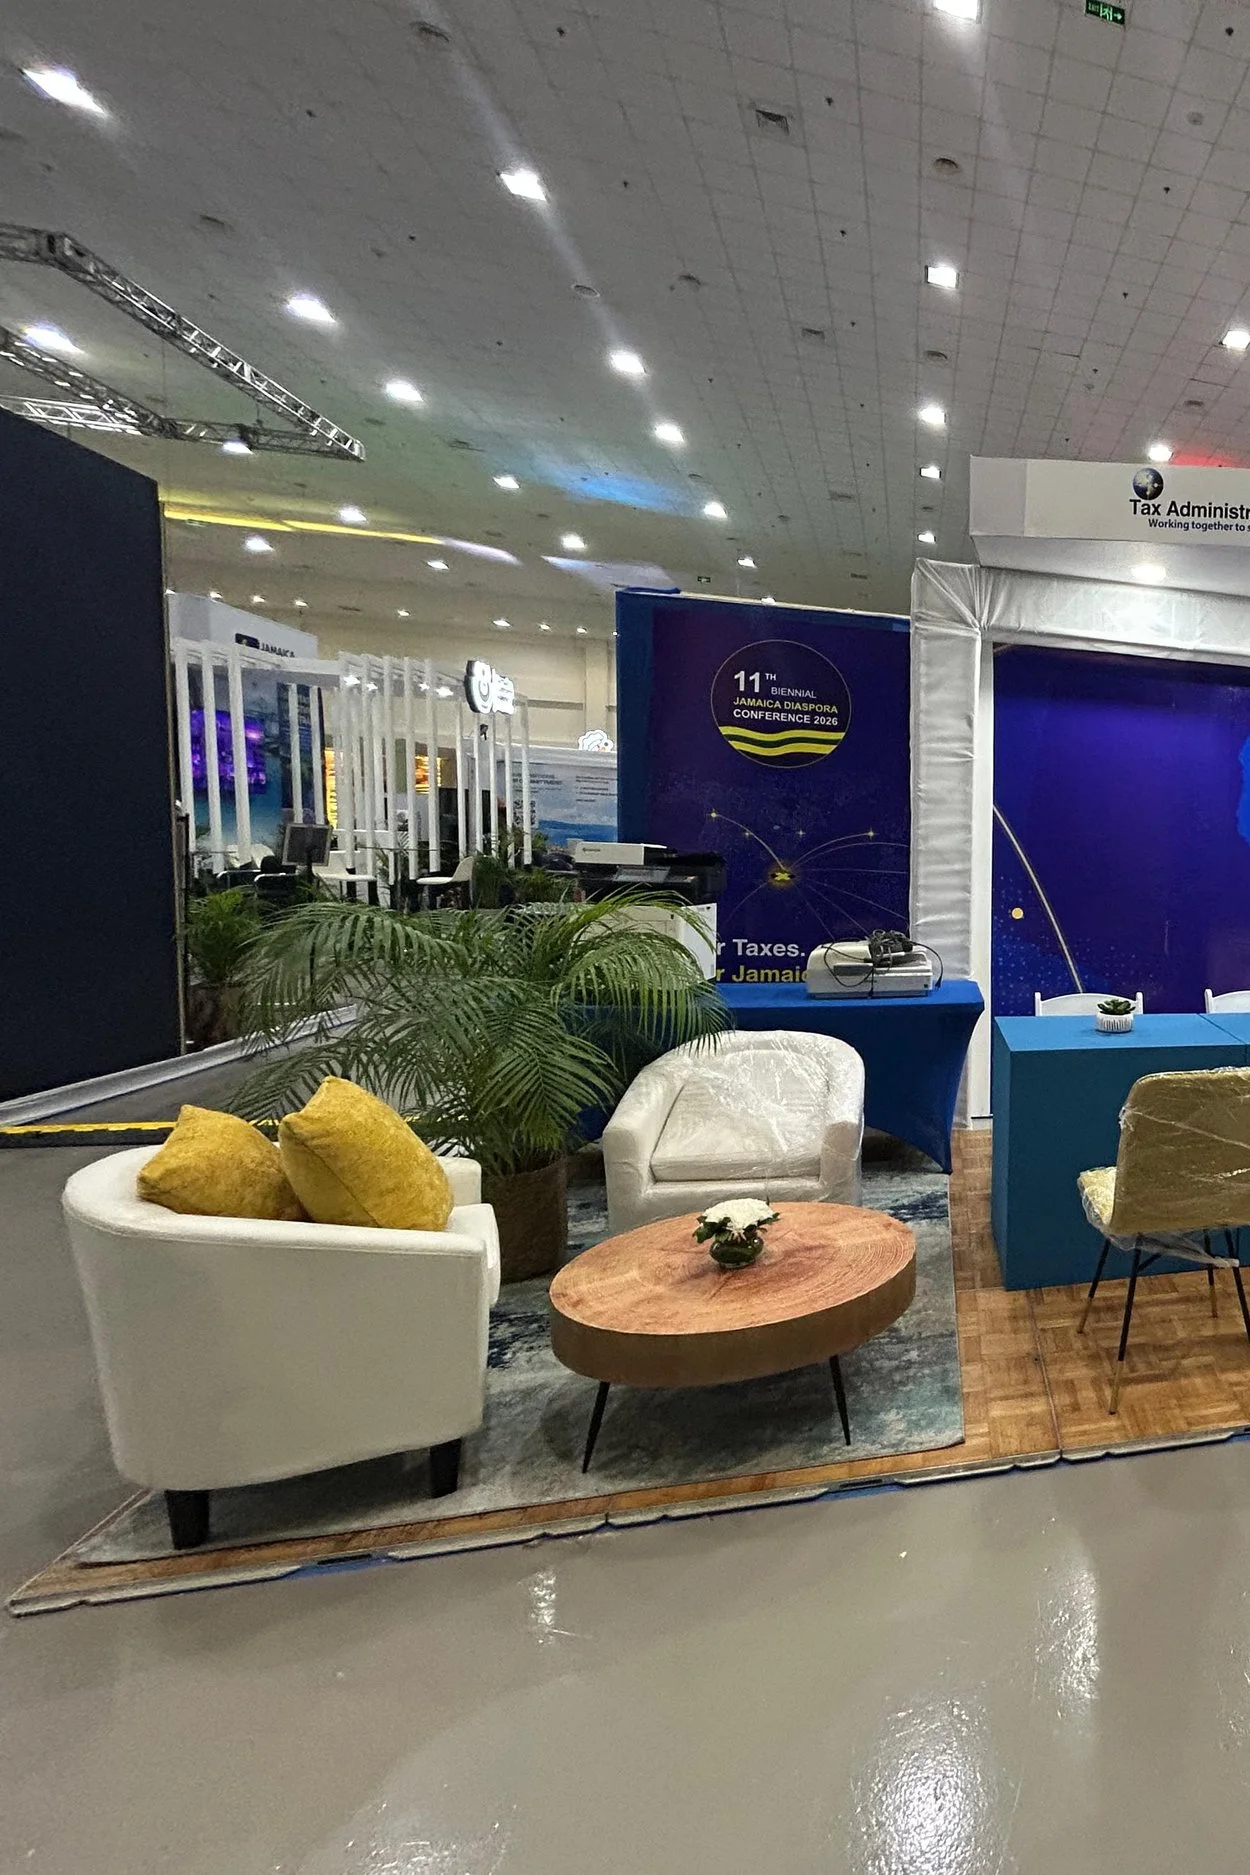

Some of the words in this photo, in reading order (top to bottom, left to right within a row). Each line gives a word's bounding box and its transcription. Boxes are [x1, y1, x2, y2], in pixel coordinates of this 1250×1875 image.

[1129, 499, 1161, 516] Tax
[1148, 519, 1189, 531] Working
[1191, 521, 1233, 532] together
[1235, 523, 1245, 531] to
[771, 687, 817, 699] BIENNIAL
[733, 697, 782, 708] JAMAICA
[784, 701, 838, 714] DIASPORA
[733, 709, 811, 724] CONFERENCE
[813, 716, 838, 726] 2026
[732, 938, 805, 957] Taxes.
[732, 965, 808, 983] Jamai
